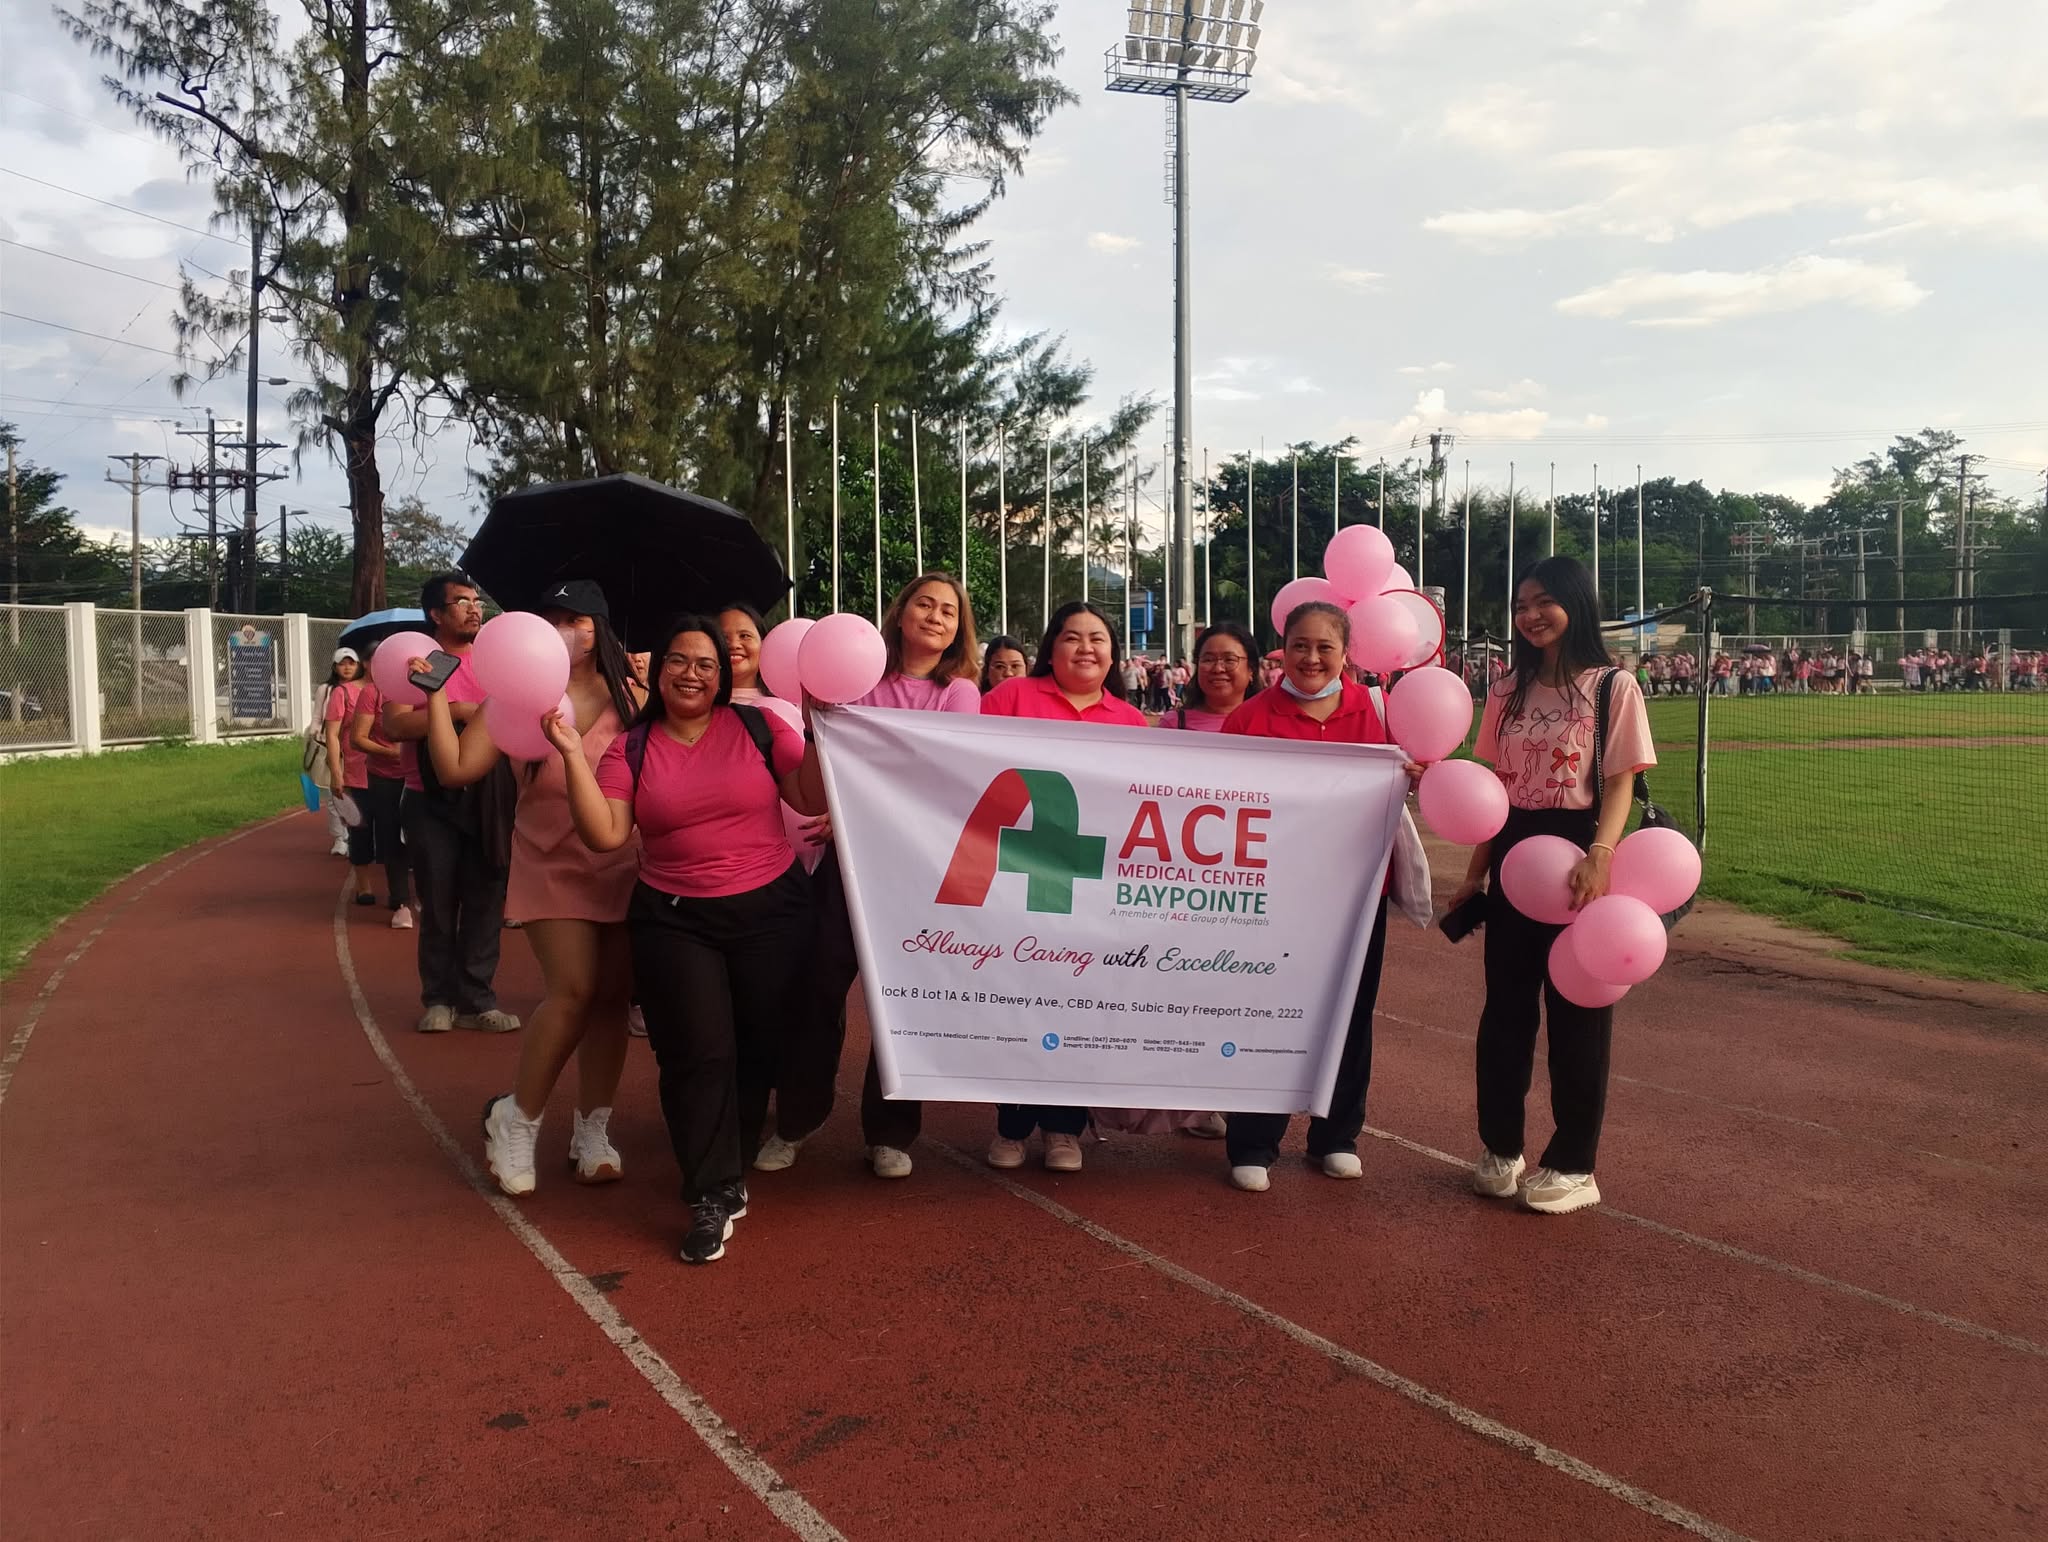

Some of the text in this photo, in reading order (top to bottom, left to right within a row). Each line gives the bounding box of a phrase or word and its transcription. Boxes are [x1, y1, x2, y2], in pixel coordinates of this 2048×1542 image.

[1128, 783, 1270, 803] ALLIED CARE EXPERTS
[1118, 800, 1271, 868] ACE
[1117, 863, 1266, 887] MEDICAL CENTER
[1116, 882, 1268, 915] BAYPOINTE
[1109, 908, 1269, 927] A member of ACE Group of Hospitals
[1013, 936, 1095, 977] Caring
[1102, 944, 1149, 968] with
[911, 987, 919, 998] 8
[922, 989, 941, 1000] Lot
[945, 990, 957, 1000] 1A
[961, 991, 970, 1002] &
[974, 992, 986, 1003] 1B
[989, 993, 1032, 1008] Dewey
[1035, 996, 1063, 1009] Ave.,
[1067, 998, 1093, 1009] CBD
[1096, 1000, 1128, 1012] Area,
[1131, 1002, 1164, 1013] Subic
[1167, 1004, 1189, 1017] Bay
[1192, 1005, 1241, 1018] Freeport
[1244, 1007, 1275, 1019] Zone,
[1277, 1008, 1303, 1019] 2222
